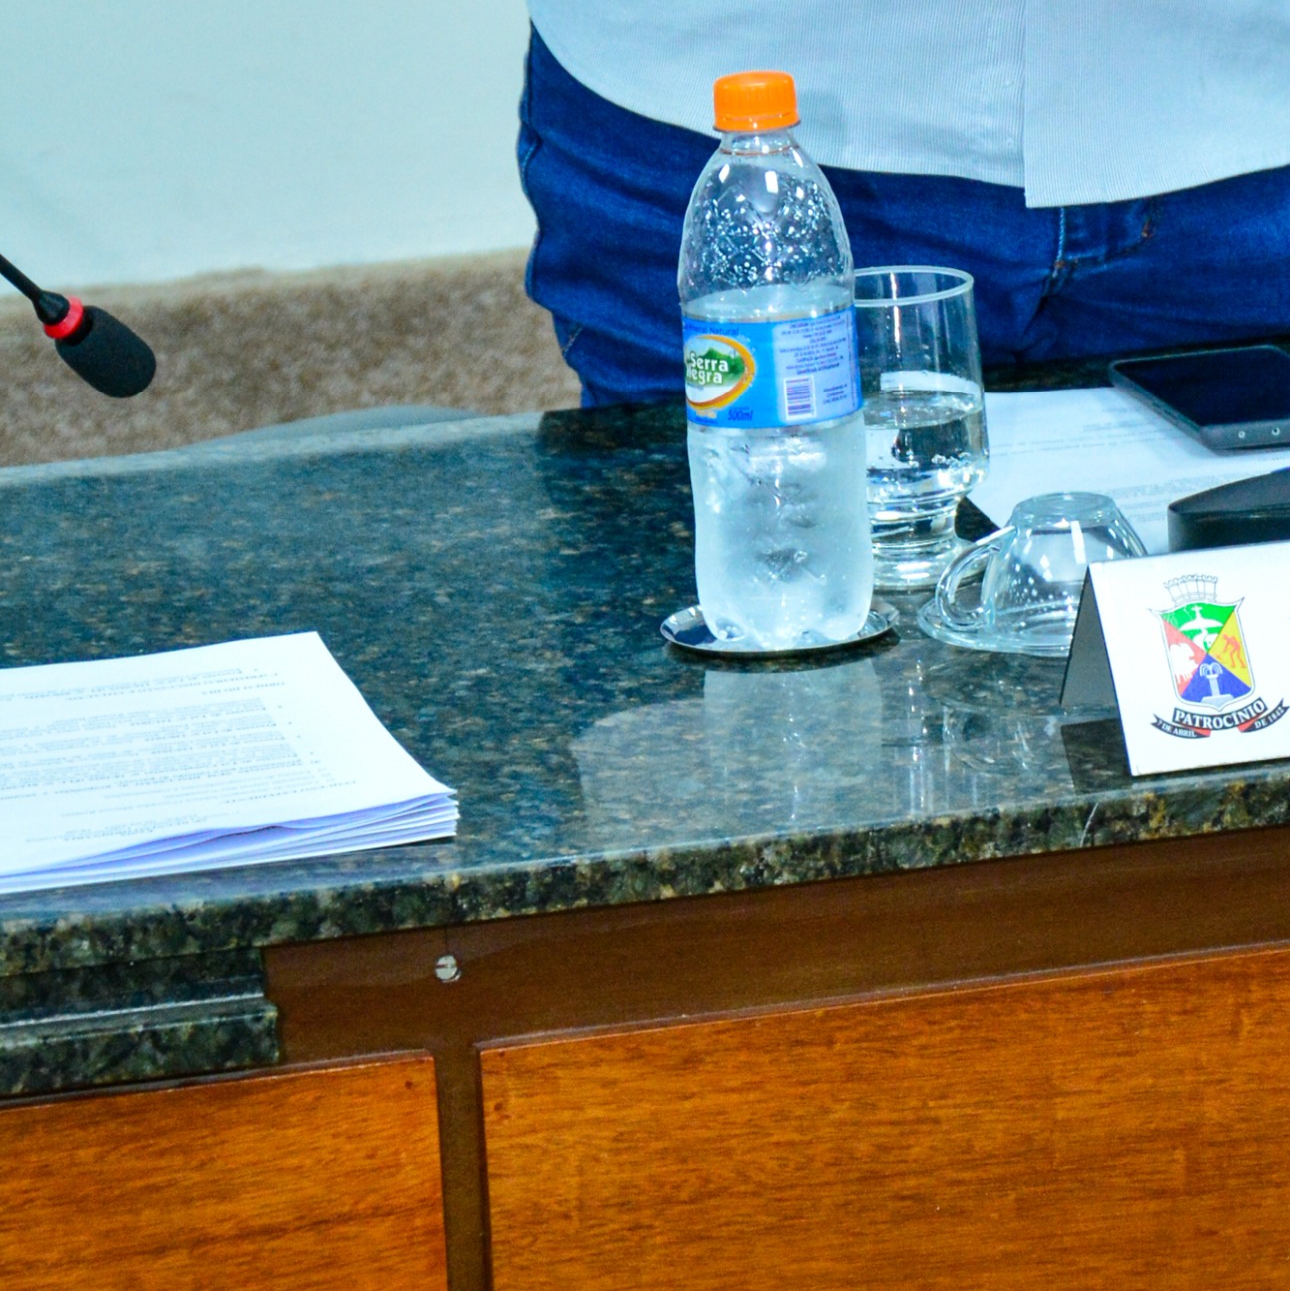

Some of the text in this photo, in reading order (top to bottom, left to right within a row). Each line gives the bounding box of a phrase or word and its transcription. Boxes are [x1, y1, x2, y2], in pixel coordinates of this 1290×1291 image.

[690, 351, 729, 373] Serra
[727, 408, 753, 421] 500ml
[1174, 699, 1266, 729] PATROCÍNIO
[1161, 722, 1173, 733] DE
[1172, 726, 1198, 738] ABRIL
[1253, 718, 1268, 729] DE
